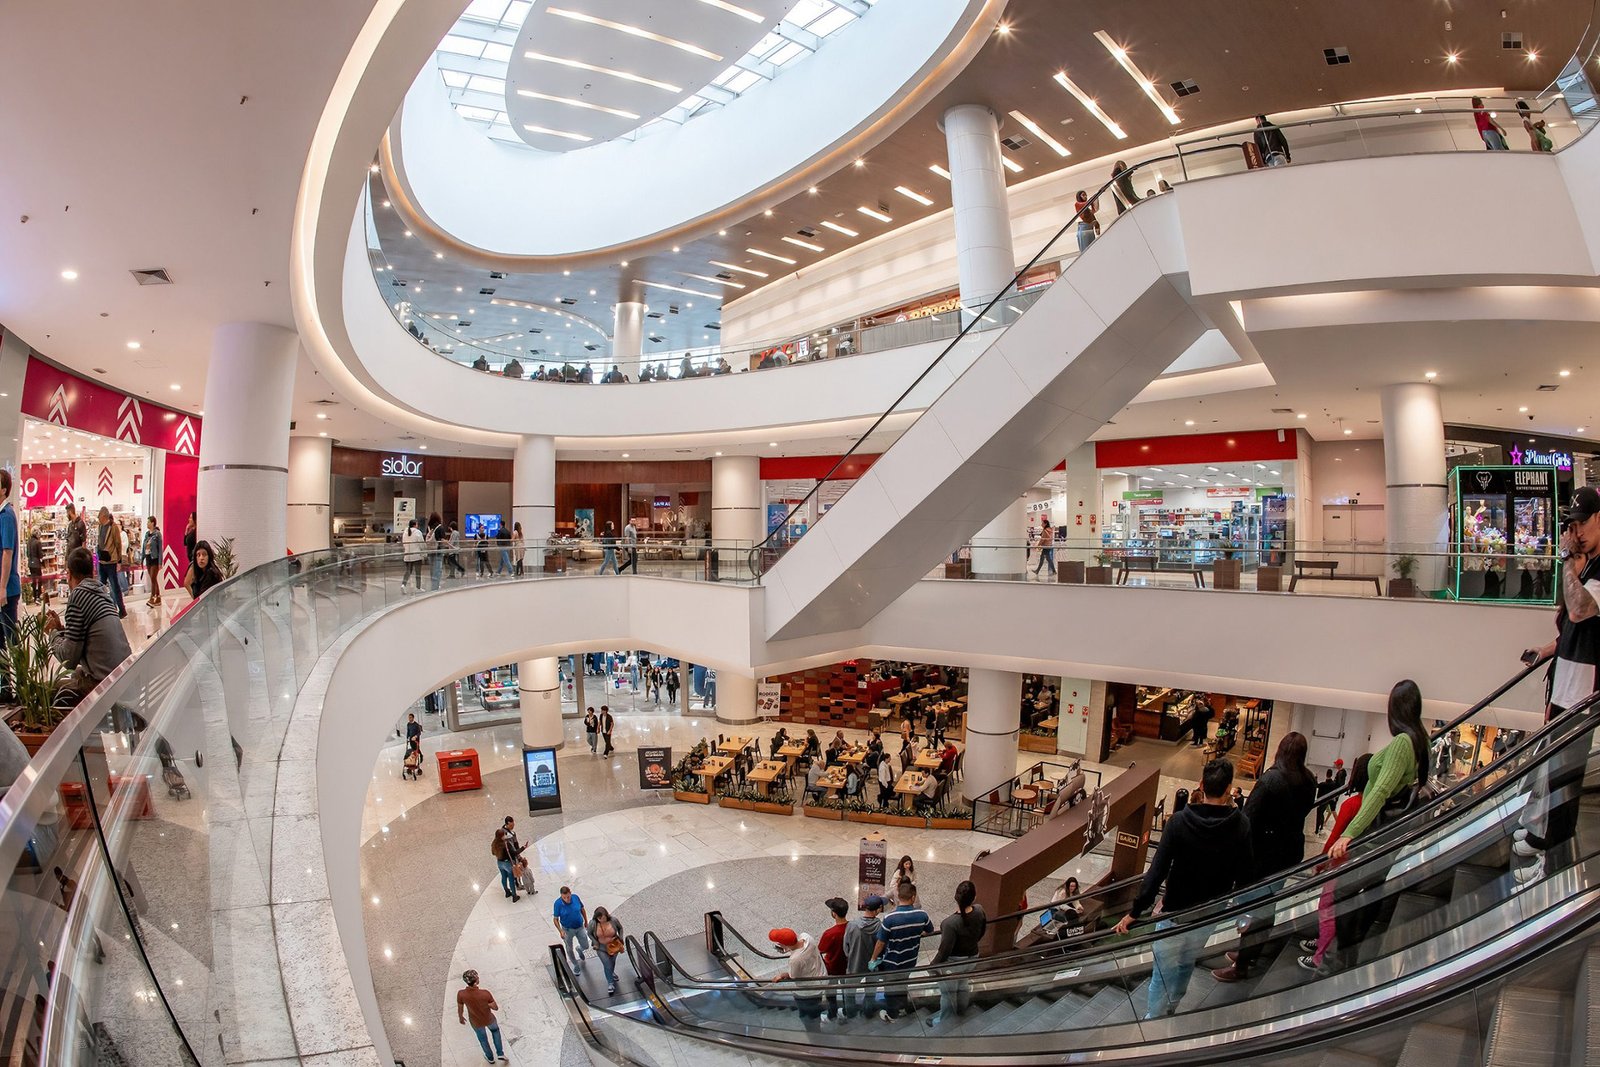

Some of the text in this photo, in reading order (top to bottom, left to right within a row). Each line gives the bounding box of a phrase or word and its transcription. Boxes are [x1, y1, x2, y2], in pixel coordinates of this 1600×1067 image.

[1524, 449, 1572, 467] Planet Girls
[1514, 471, 1549, 485] ELEPHANT
